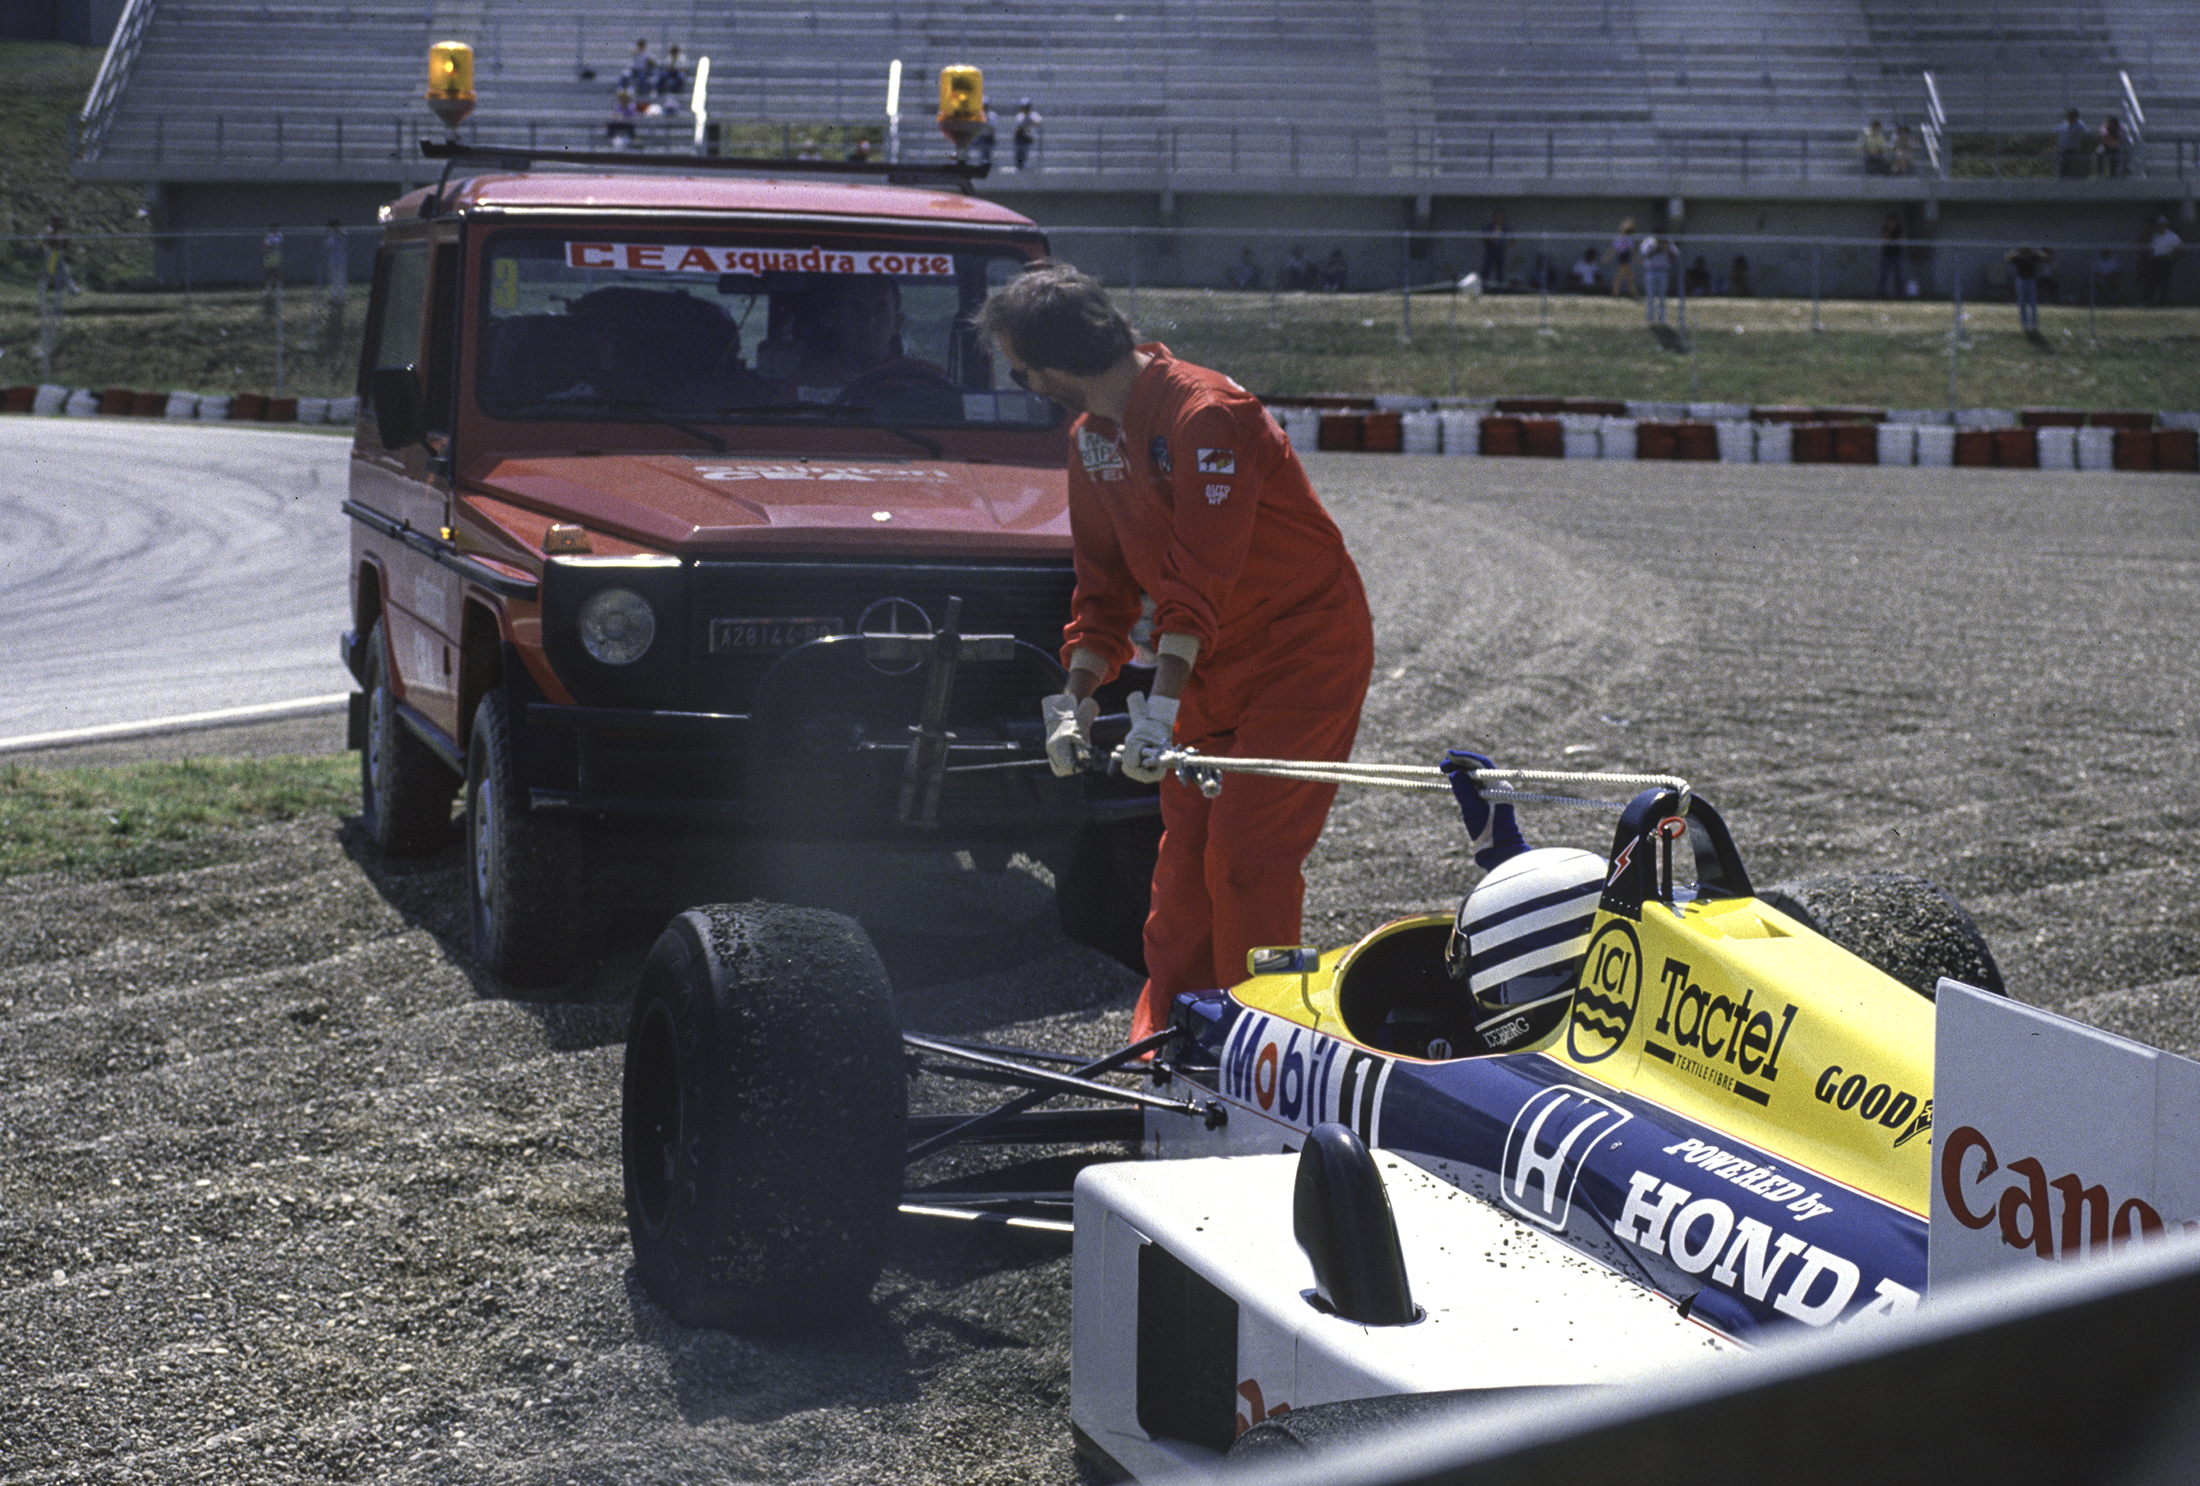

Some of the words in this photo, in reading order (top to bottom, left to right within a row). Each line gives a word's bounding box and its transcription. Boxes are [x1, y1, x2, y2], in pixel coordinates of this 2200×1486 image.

[570, 243, 718, 272] CEA
[725, 246, 855, 277] squadra
[868, 253, 950, 275] corse
[1592, 943, 1632, 995] ICI
[1655, 957, 1799, 1082] Tactel
[1226, 1011, 1341, 1128] Mobil
[1676, 1054, 1709, 1080] TEXTILE
[1708, 1070, 1734, 1091] FIBRE
[1815, 1065, 1942, 1157] GOOD
[1663, 1138, 1806, 1201] POWERED
[1786, 1193, 1833, 1221] by
[1941, 1126, 2199, 1263] Cano
